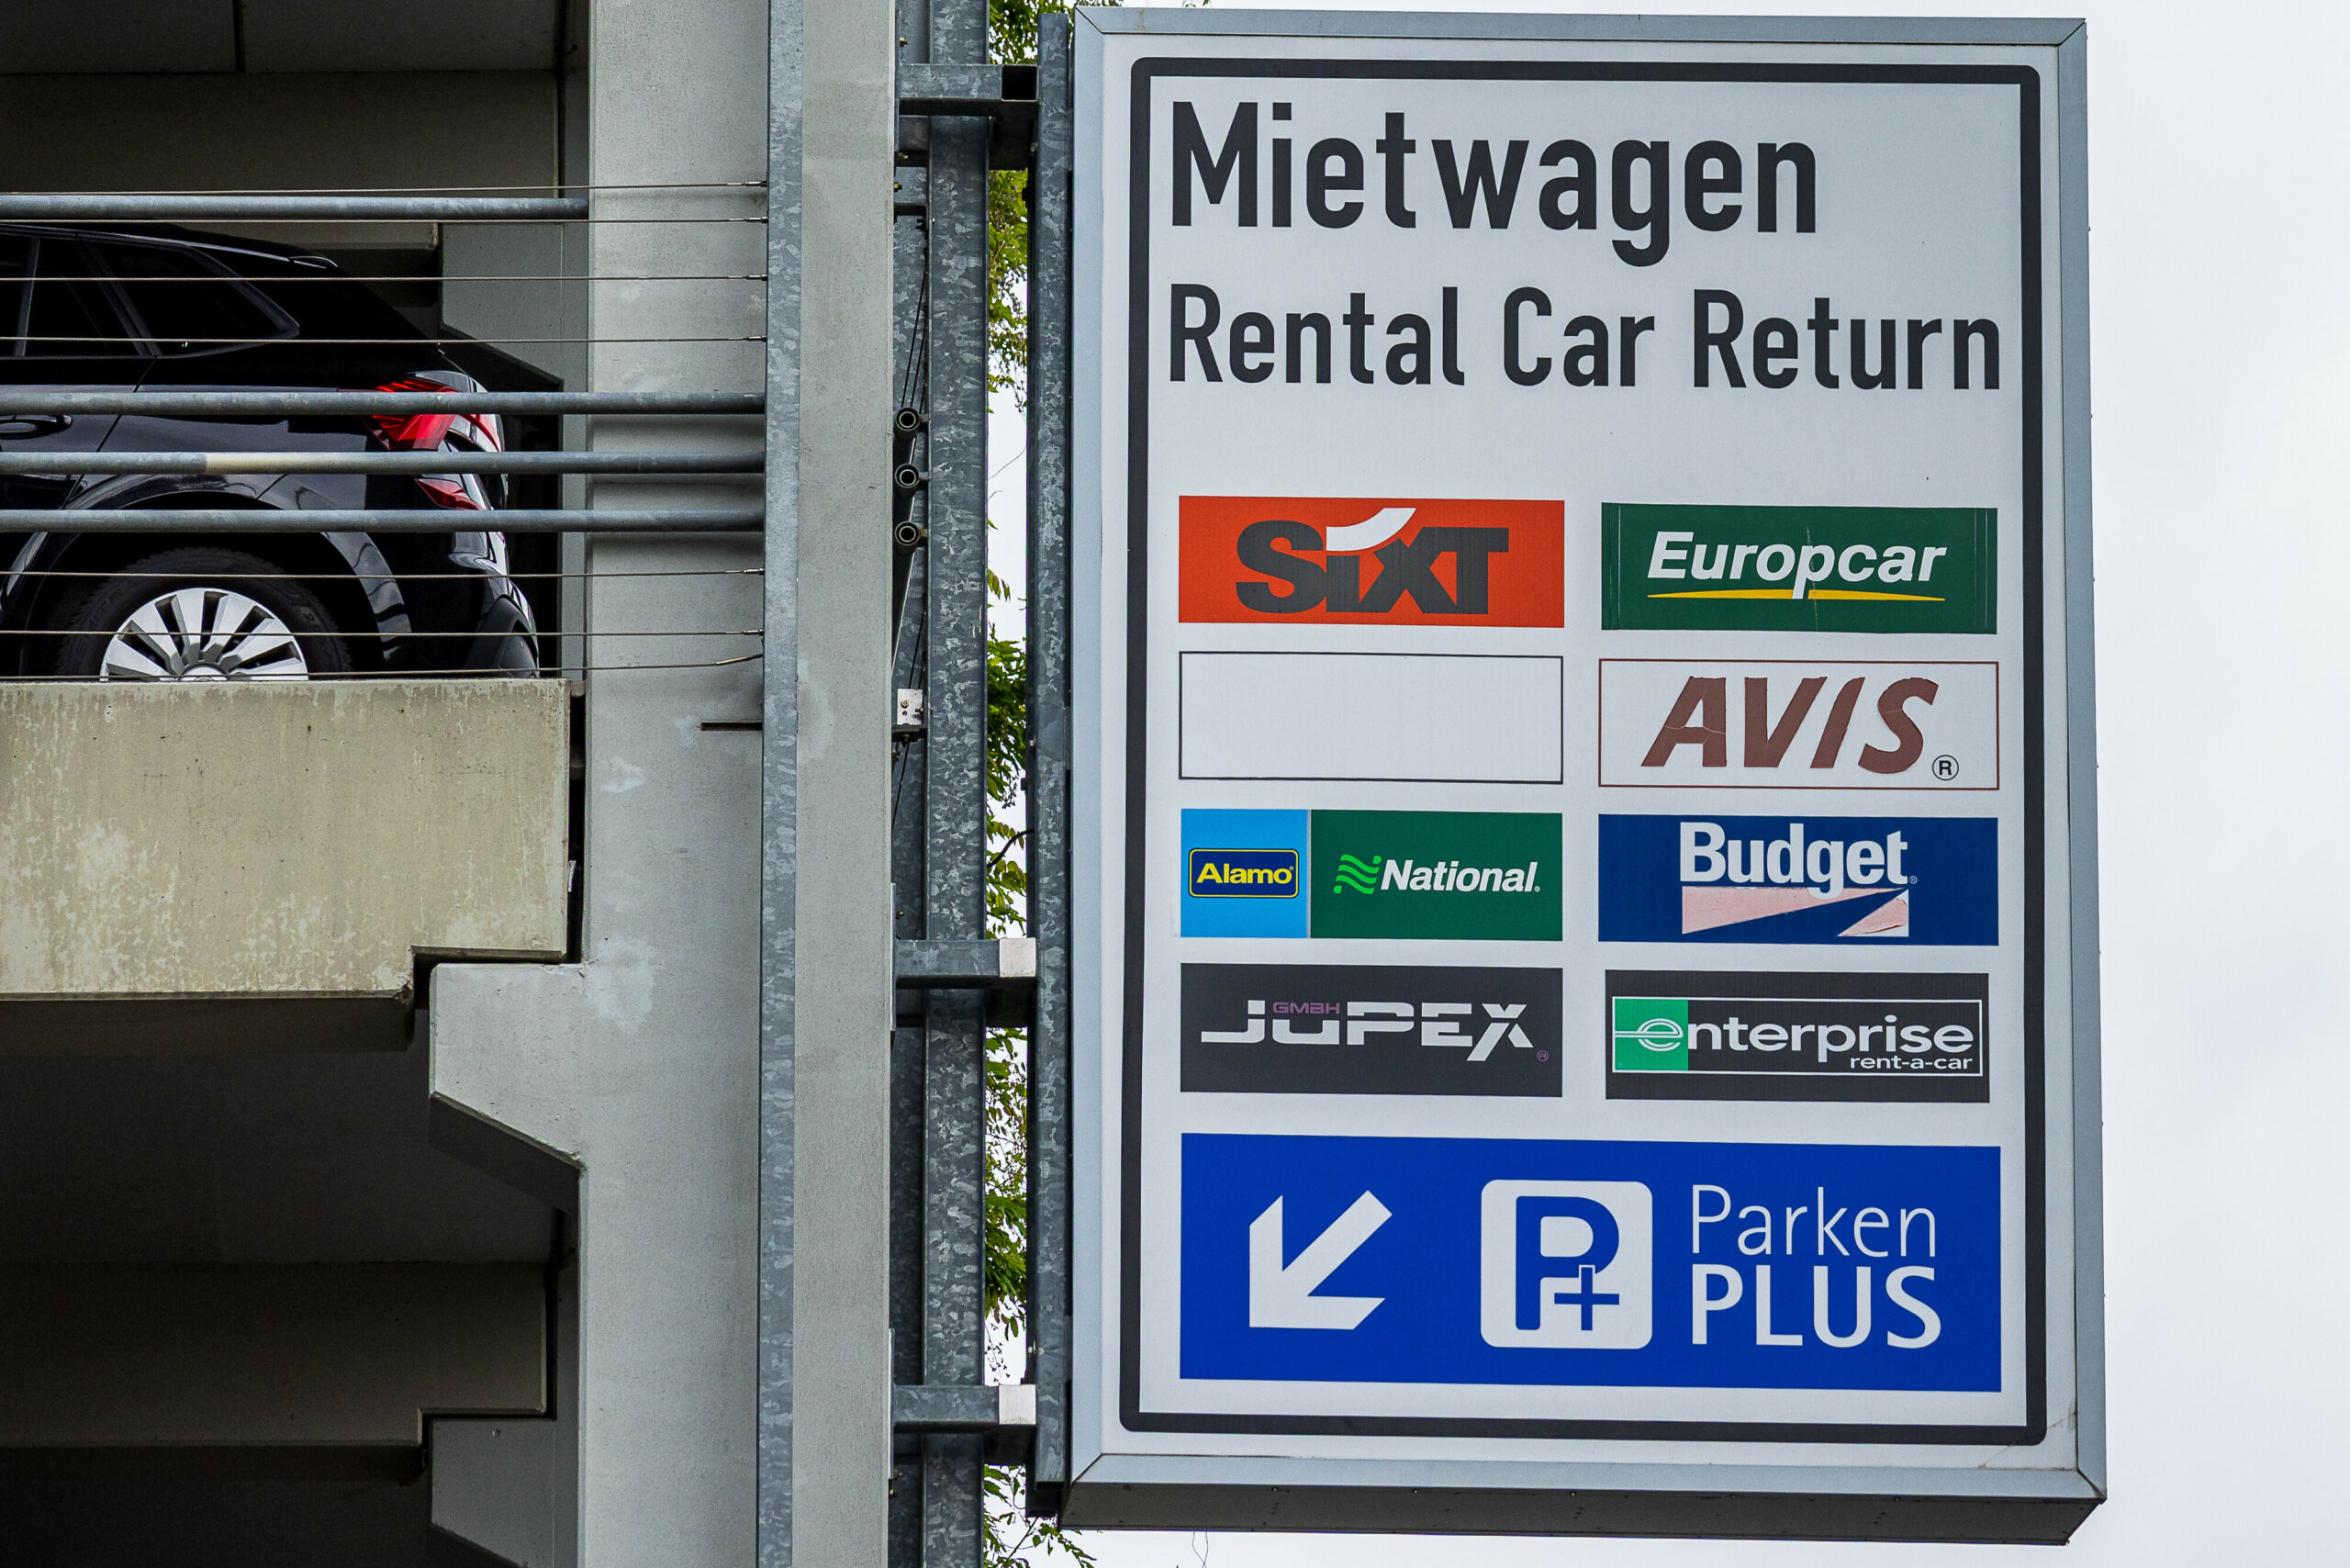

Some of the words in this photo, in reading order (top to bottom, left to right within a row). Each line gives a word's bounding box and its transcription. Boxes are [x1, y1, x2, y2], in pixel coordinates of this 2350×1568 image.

[1171, 101, 1817, 267] Mietwagen
[1169, 283, 1465, 386] Rental
[1503, 286, 1655, 388] Car
[1694, 289, 2001, 390] Return
[1647, 531, 1947, 599] Europcar
[1640, 676, 1939, 774] AVIS
[1196, 862, 1292, 884] Alamo
[1381, 859, 1539, 892] National
[1680, 822, 1908, 900] Budget
[1636, 1014, 1974, 1063] enterprise
[1850, 1055, 1973, 1070] rent-a-car
[1692, 1184, 1937, 1258] Parken
[1692, 1263, 1942, 1350] PLUS
